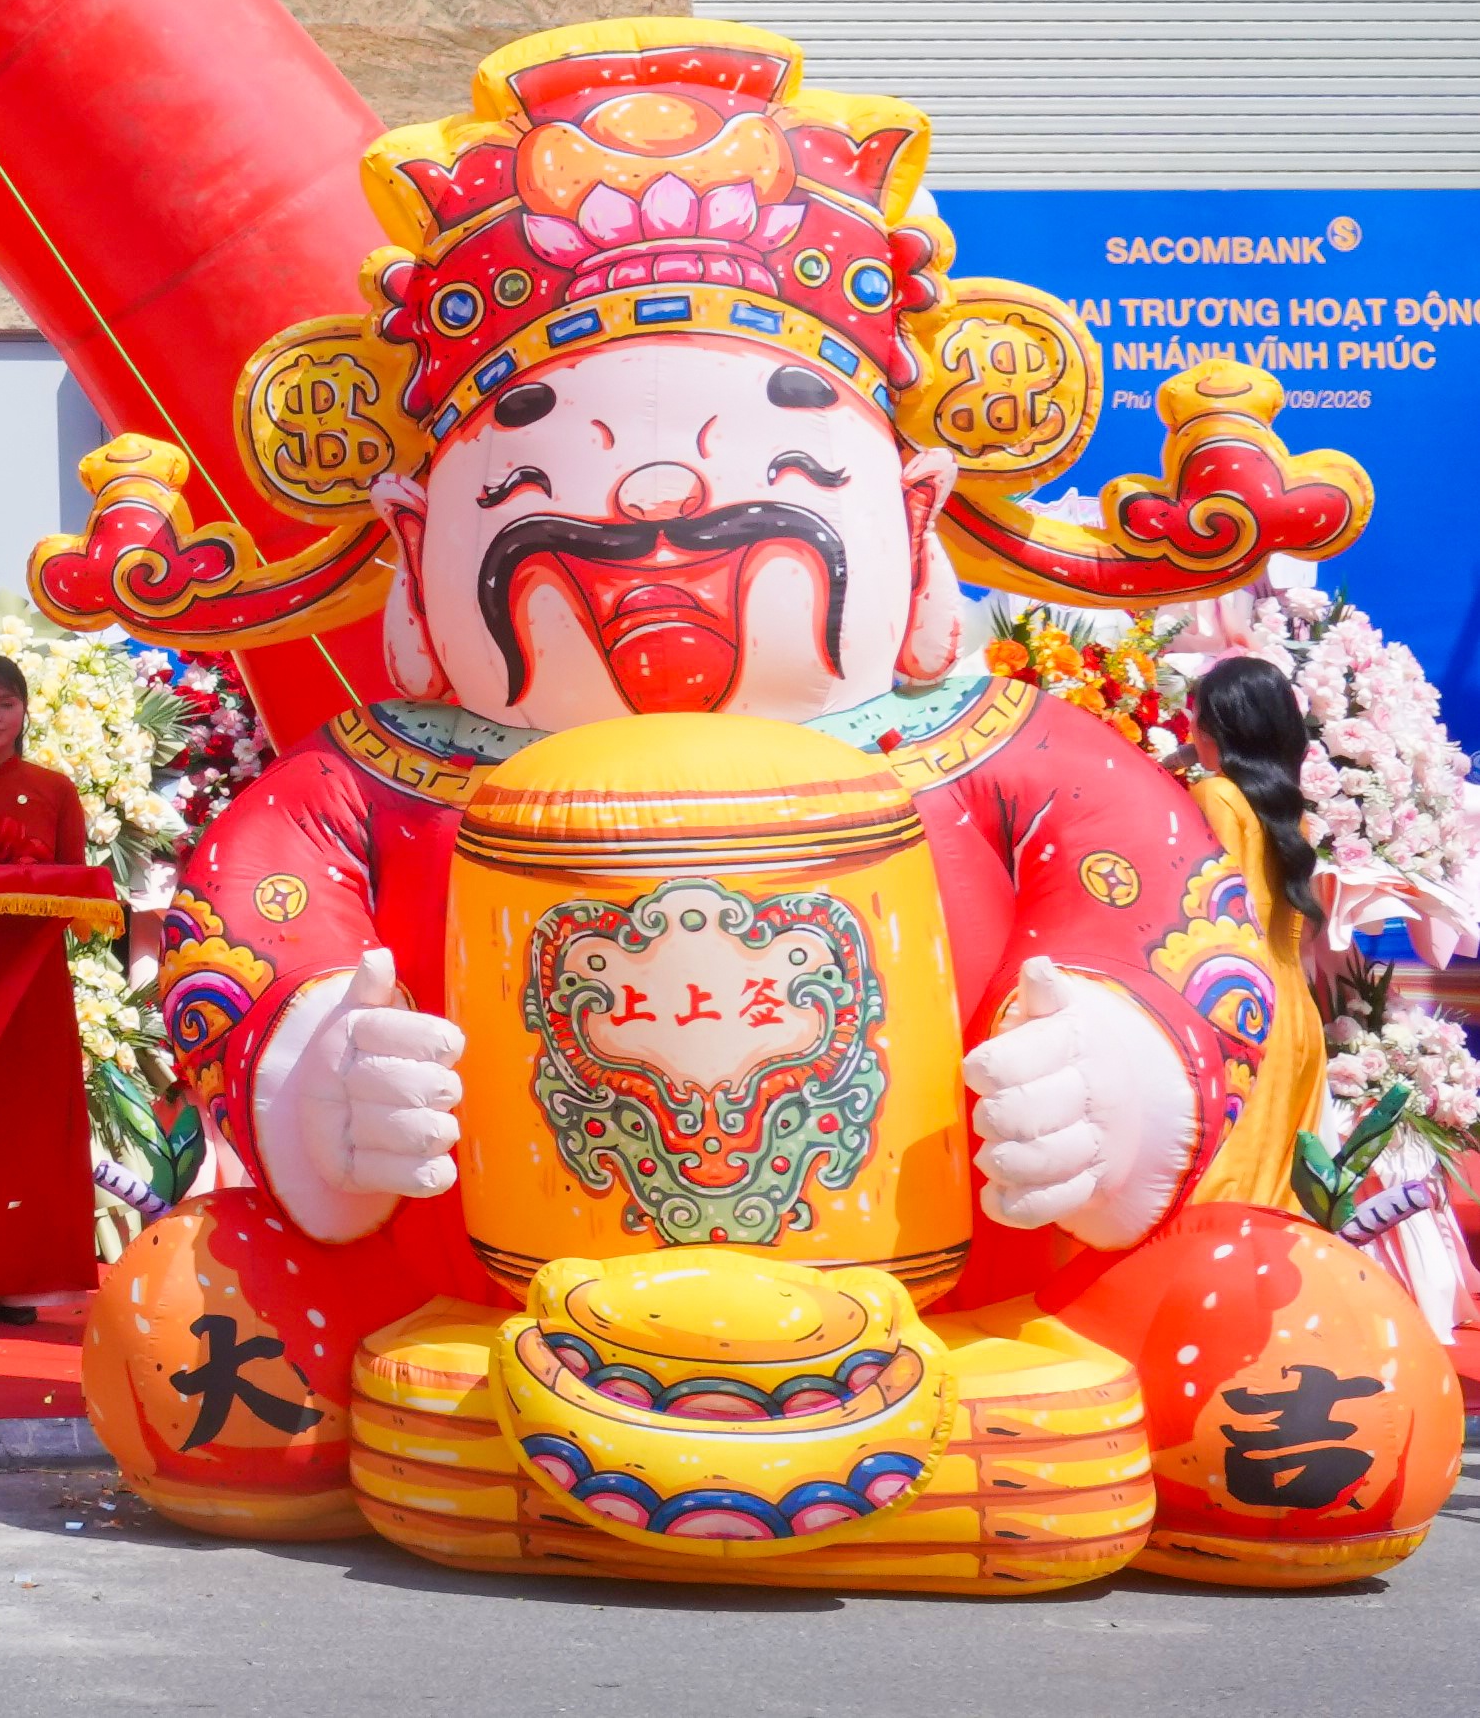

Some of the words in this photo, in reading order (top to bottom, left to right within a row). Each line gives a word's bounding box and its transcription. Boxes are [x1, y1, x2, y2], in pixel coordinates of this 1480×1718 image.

[1106, 235, 1326, 264] SACOMBANK
[1120, 297, 1280, 327] TRƯƠNG
[1290, 298, 1387, 331] HOẠT
[1113, 336, 1235, 370] NHÁNH
[1245, 336, 1329, 370] VĨNH
[1339, 336, 1436, 370] PHÚC
[1112, 389, 1151, 410] Phú
[170, 1313, 323, 1453] 大
[1221, 1364, 1387, 1512] 吉
